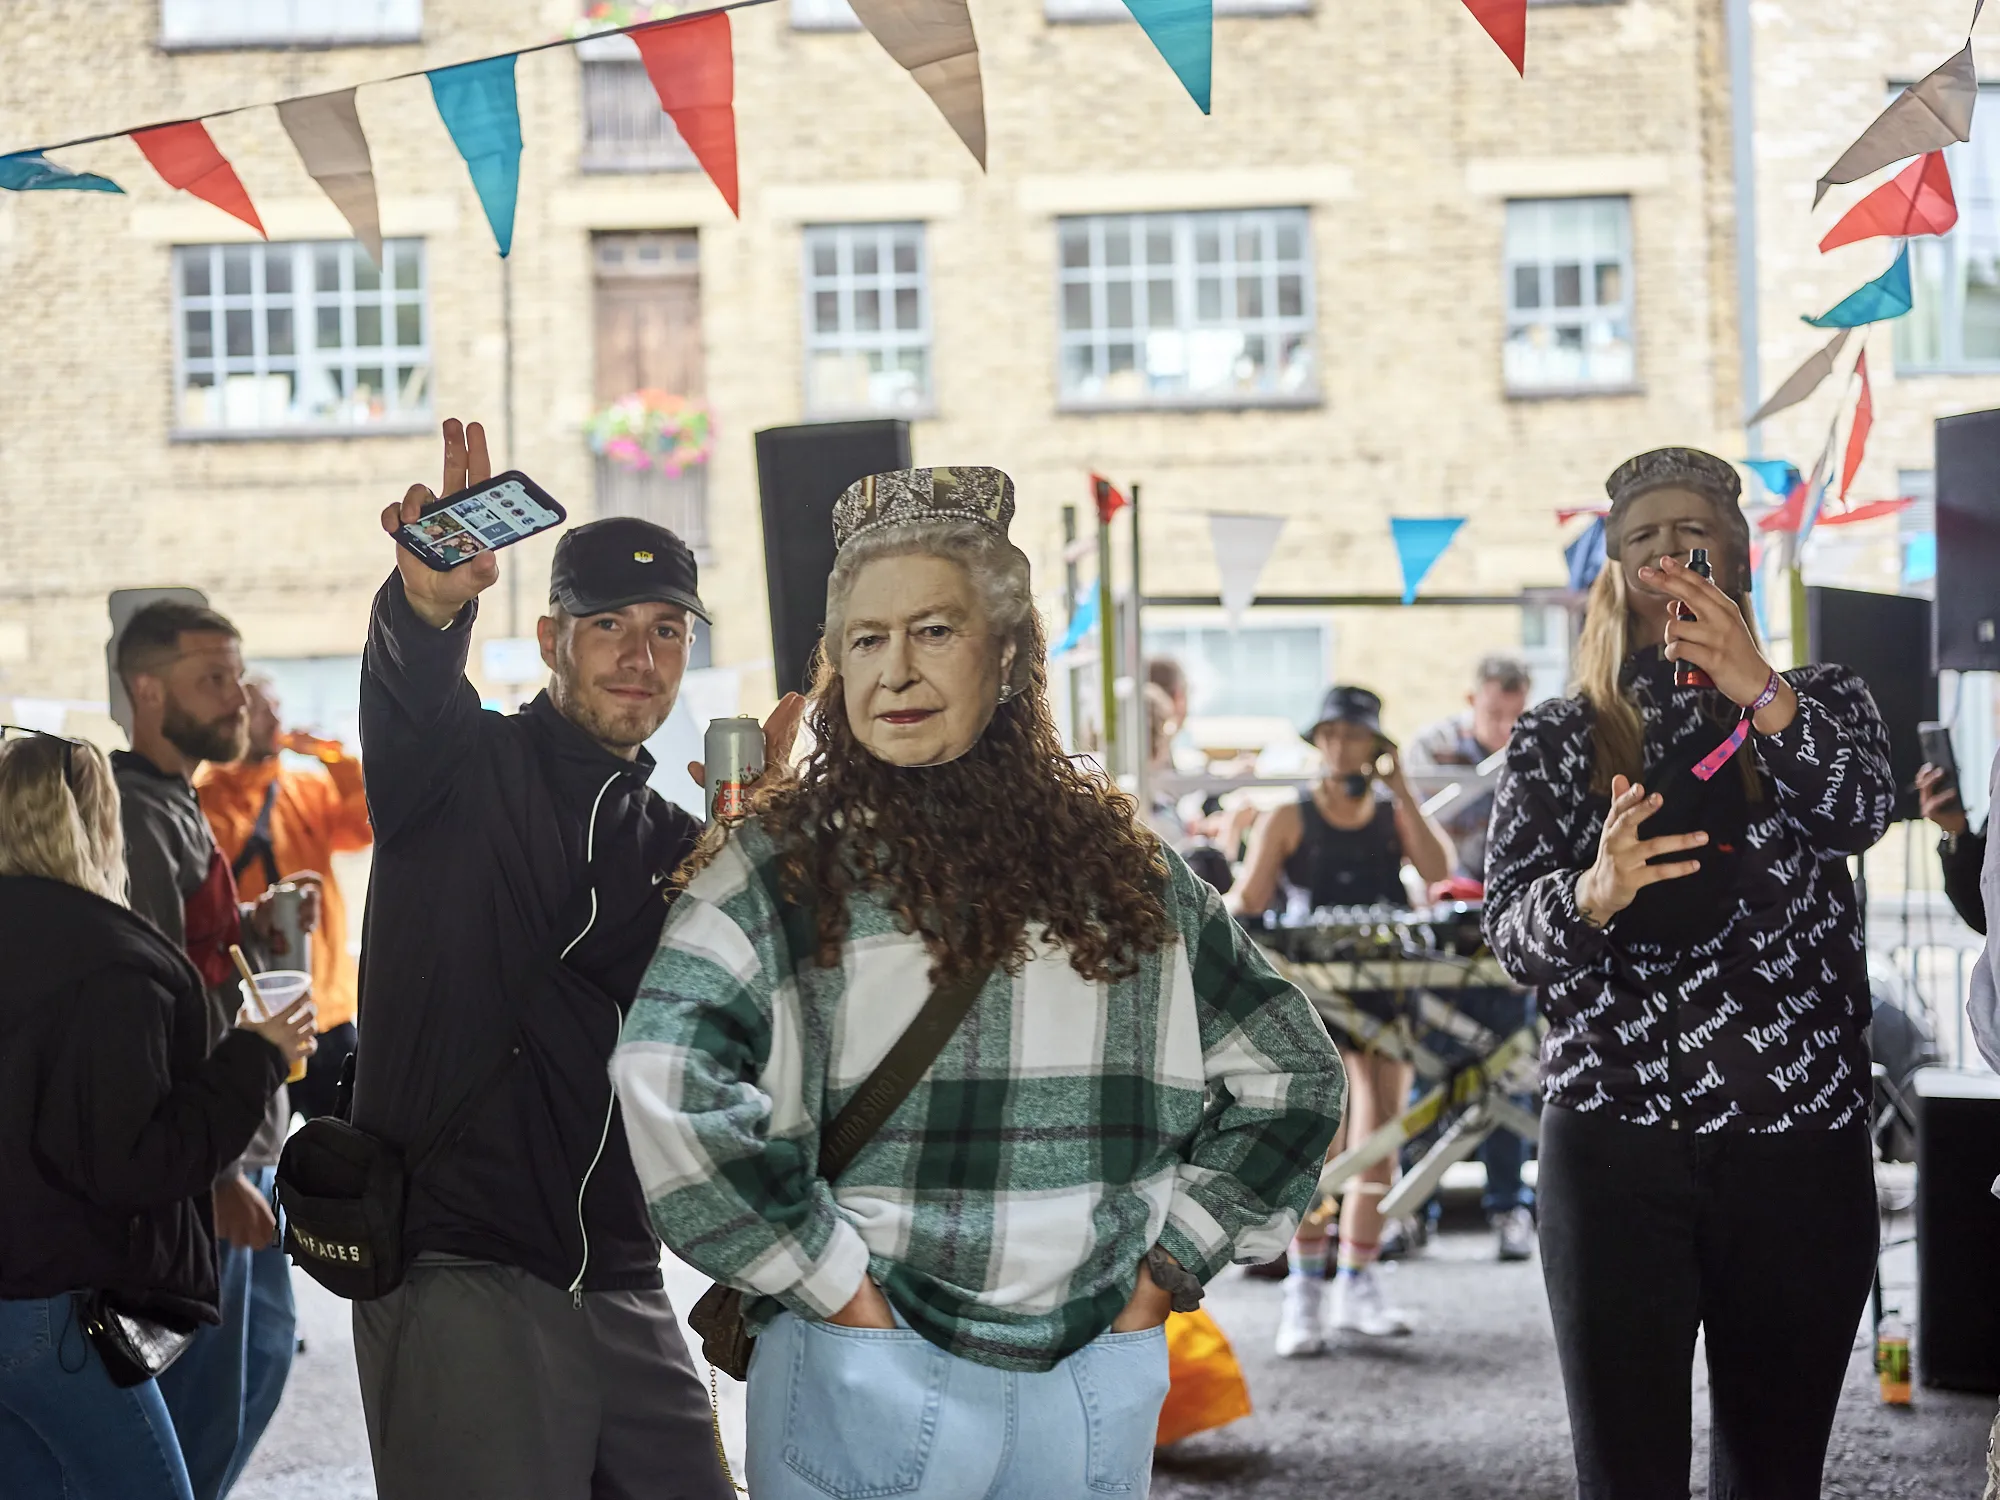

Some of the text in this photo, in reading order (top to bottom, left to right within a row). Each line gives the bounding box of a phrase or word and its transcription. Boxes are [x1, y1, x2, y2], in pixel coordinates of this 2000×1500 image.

[1677, 990, 1743, 1054] Apparel
[1742, 1002, 1797, 1054] Regal
[1766, 1038, 1817, 1093] Regal
